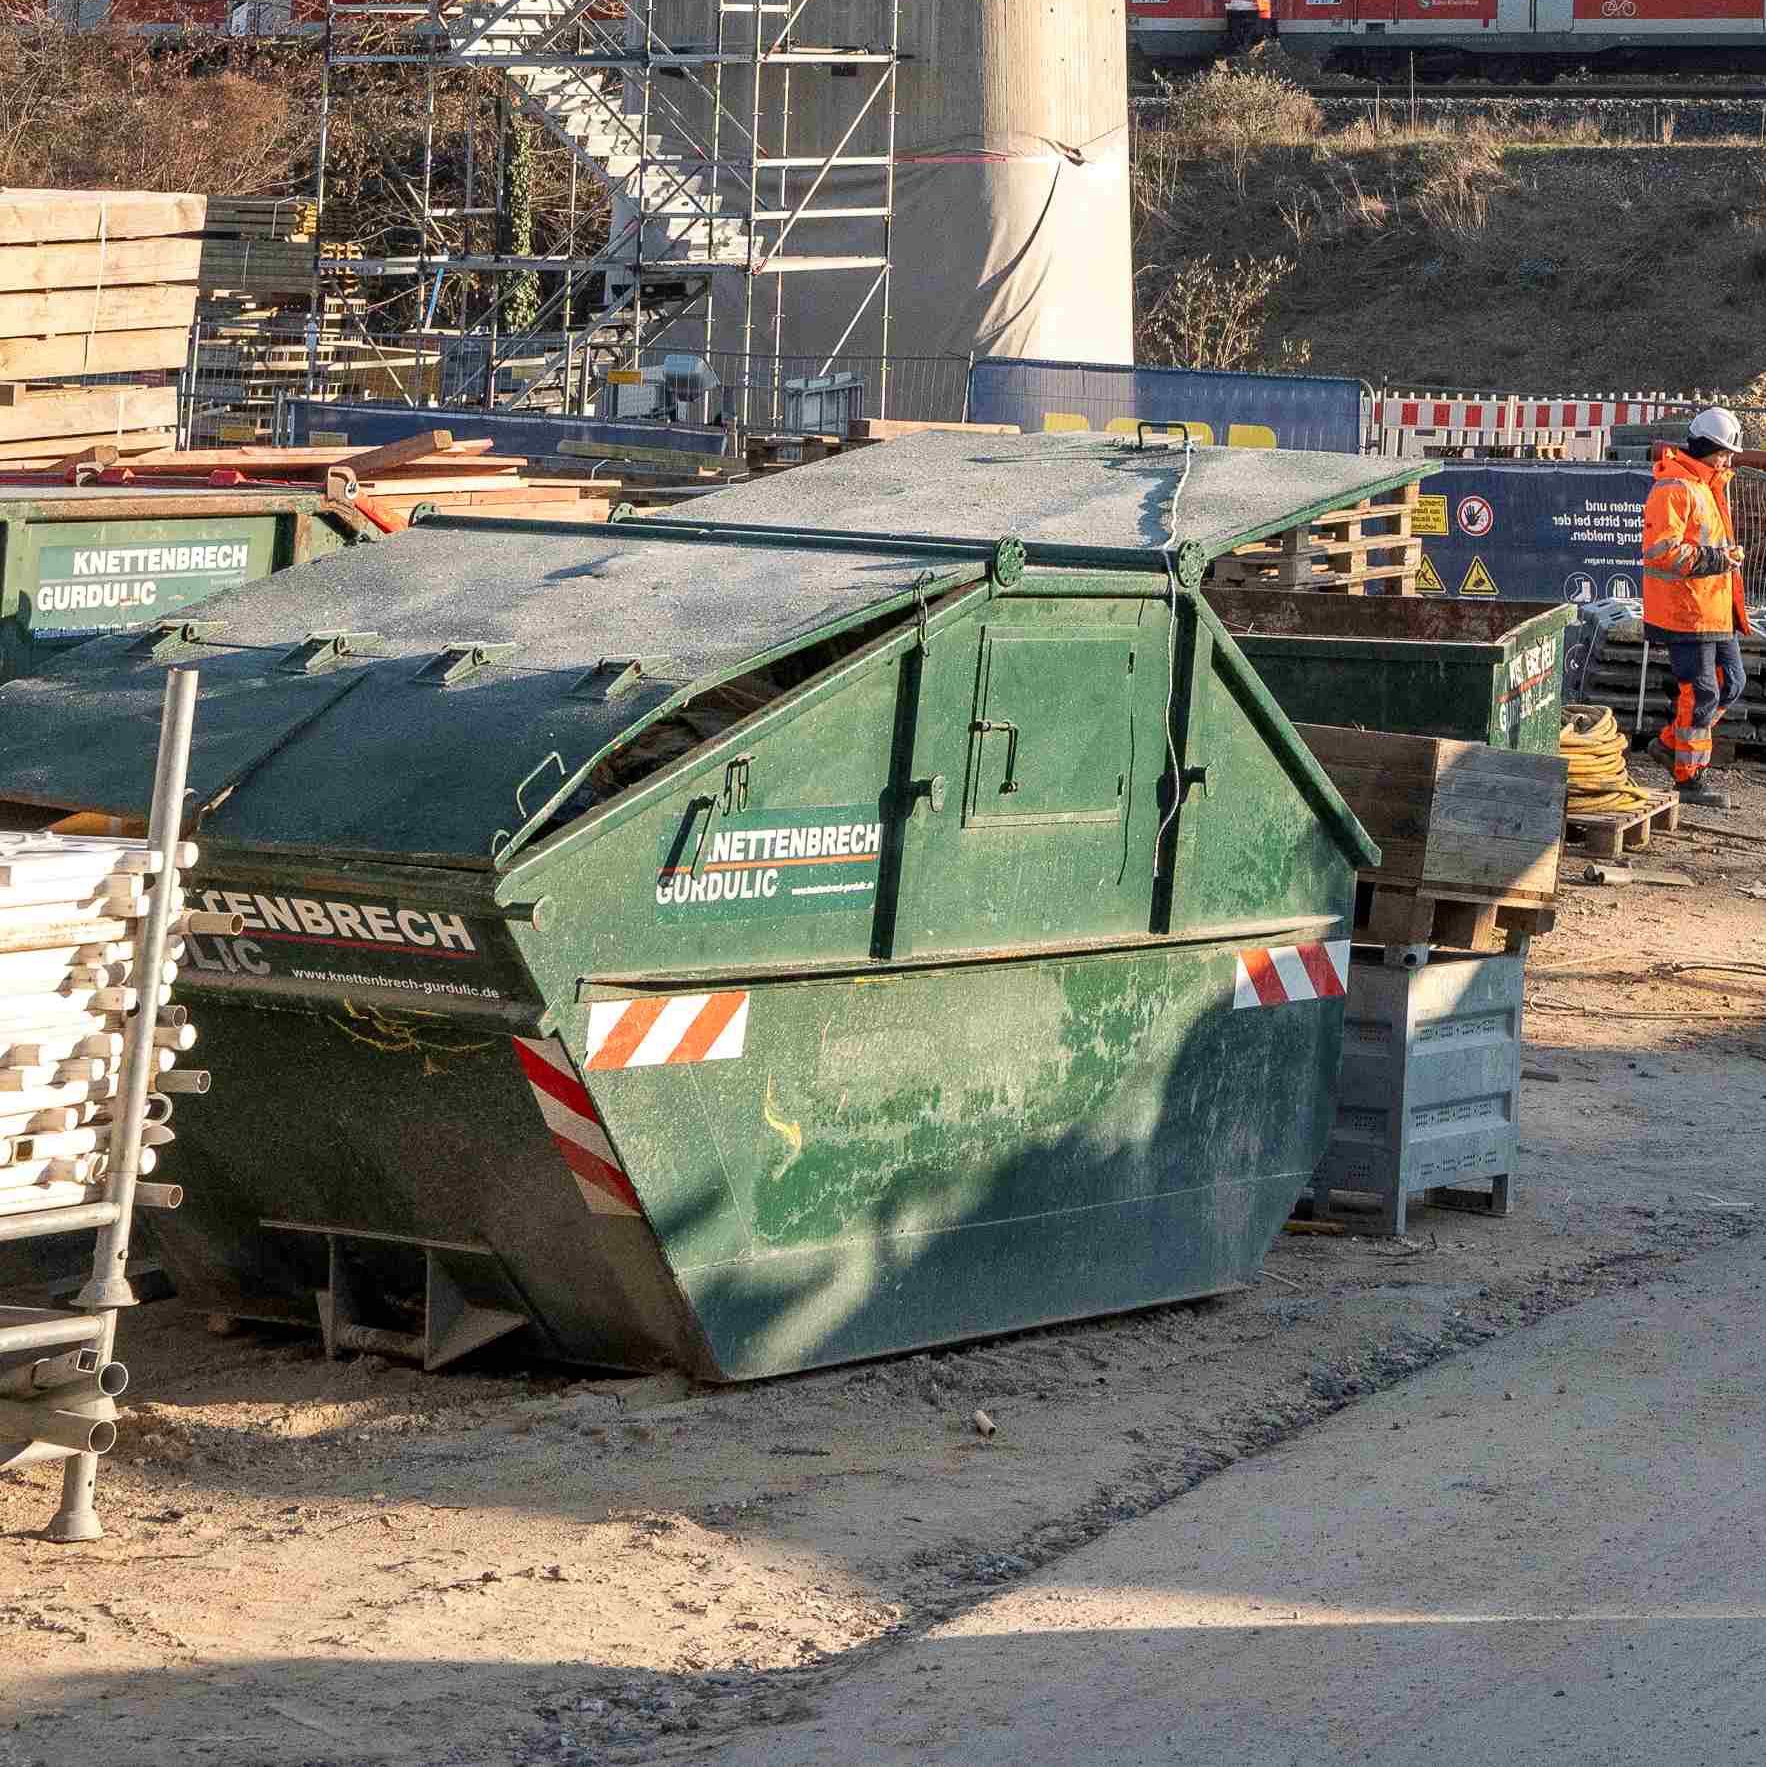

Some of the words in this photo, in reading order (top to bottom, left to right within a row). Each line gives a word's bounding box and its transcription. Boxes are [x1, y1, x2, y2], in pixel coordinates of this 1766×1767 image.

[73, 545, 248, 575] KNETTENBRECH
[38, 581, 156, 612] GURDULIC
[291, 968, 500, 999] www.knettenbrech-gurdulic.de
